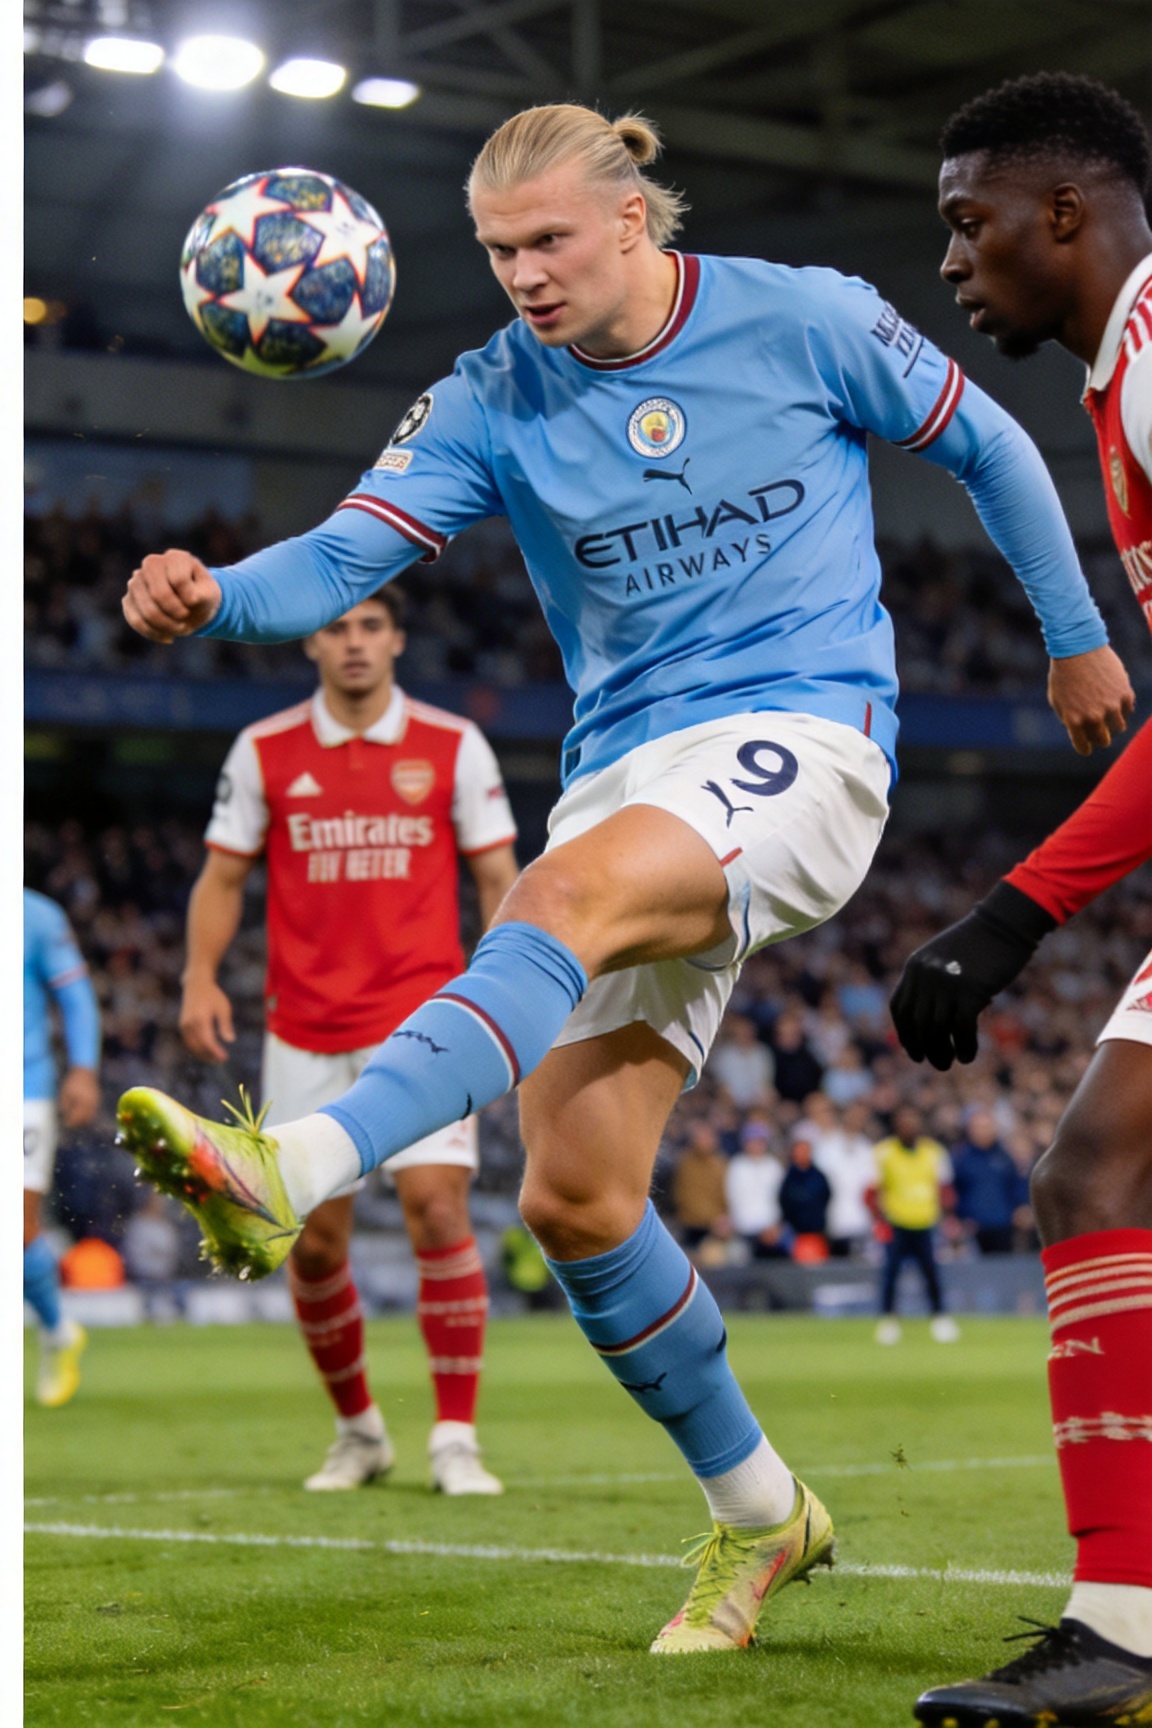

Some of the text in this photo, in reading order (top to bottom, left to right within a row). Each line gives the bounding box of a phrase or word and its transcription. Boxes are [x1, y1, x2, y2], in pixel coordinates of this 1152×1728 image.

[574, 478, 806, 570] ETIHAD
[625, 533, 773, 598] AIRWAYS
[729, 739, 799, 797] 9
[287, 809, 434, 852] Emirates
